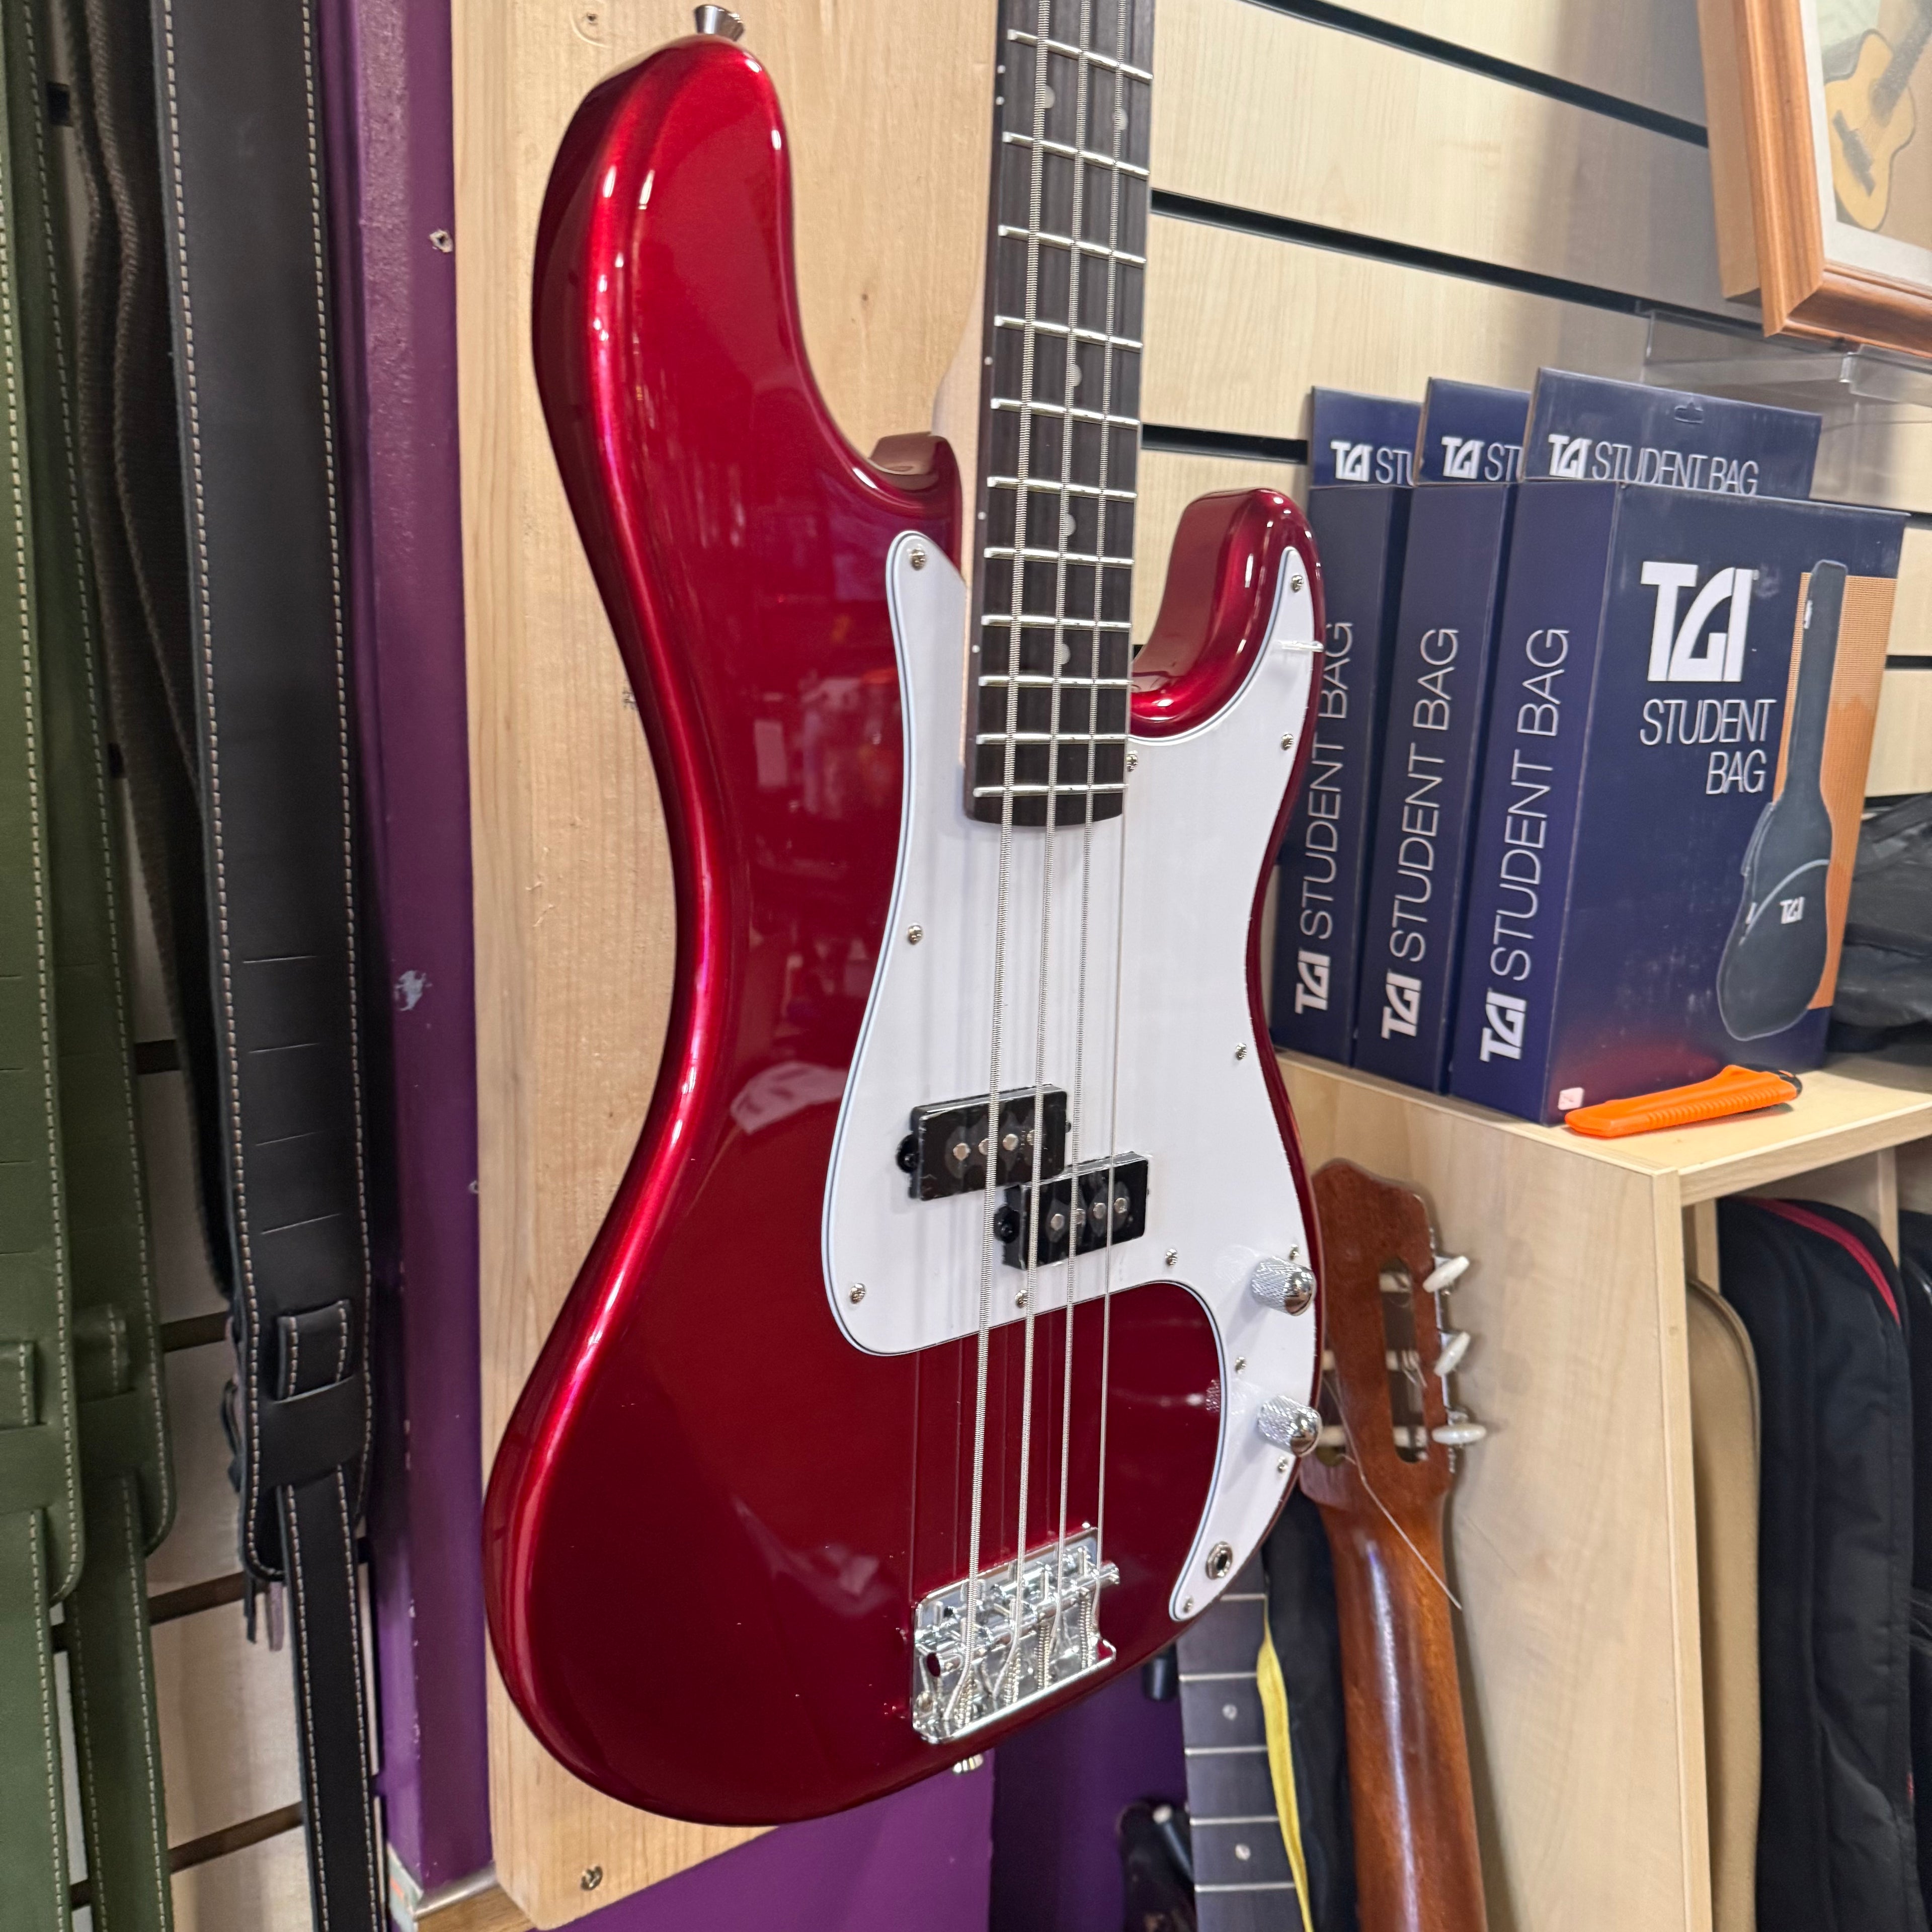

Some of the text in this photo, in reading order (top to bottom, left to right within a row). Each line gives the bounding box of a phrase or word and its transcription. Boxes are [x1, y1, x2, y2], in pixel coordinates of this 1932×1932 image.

[1330, 439, 1374, 482] TGI
[1441, 436, 1485, 479] TGI
[1548, 434, 1759, 496] TGI STUDENT BAG
[1641, 561, 1753, 682] TGI
[1640, 698, 1778, 746] STUDENT
[1706, 749, 1767, 795] BAG
[1295, 622, 1353, 1015] TGI STUDENT BAG
[1381, 628, 1459, 1039] TGI STUDENT BAG
[1479, 628, 1570, 1063] TGI STUDENT BAG
